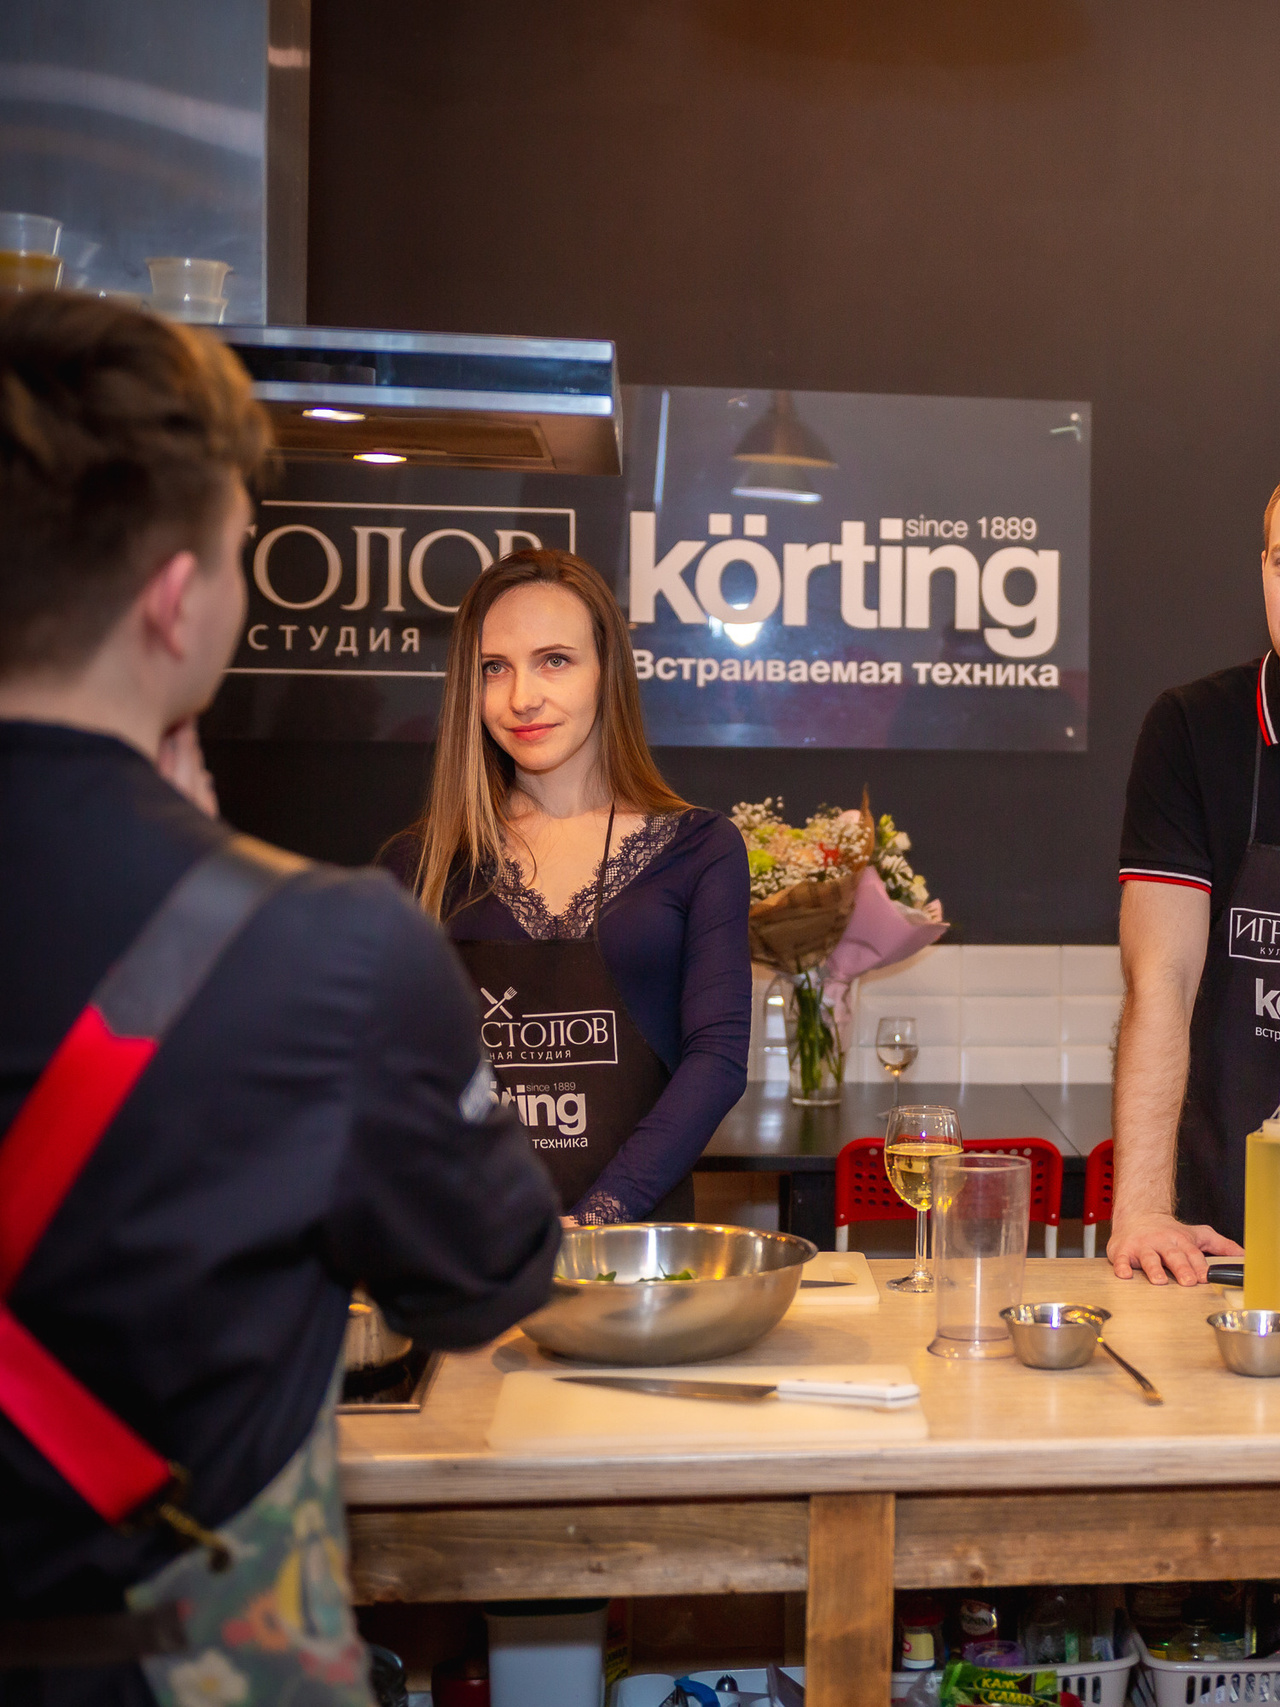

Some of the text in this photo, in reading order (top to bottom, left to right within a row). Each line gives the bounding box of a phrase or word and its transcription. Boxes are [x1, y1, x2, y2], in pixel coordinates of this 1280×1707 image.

[904, 513, 1038, 541] since 1889
[247, 523, 543, 614] ОЛО
[629, 510, 1060, 658] körting
[247, 623, 421, 658] СТУДИЯ
[633, 649, 1060, 688] Встраиваемая техника
[480, 1017, 609, 1048] СТОЛОВ
[520, 1049, 572, 1061] СТУДИЯ
[526, 1081, 576, 1092] since 1889
[531, 1137, 589, 1150] техника
